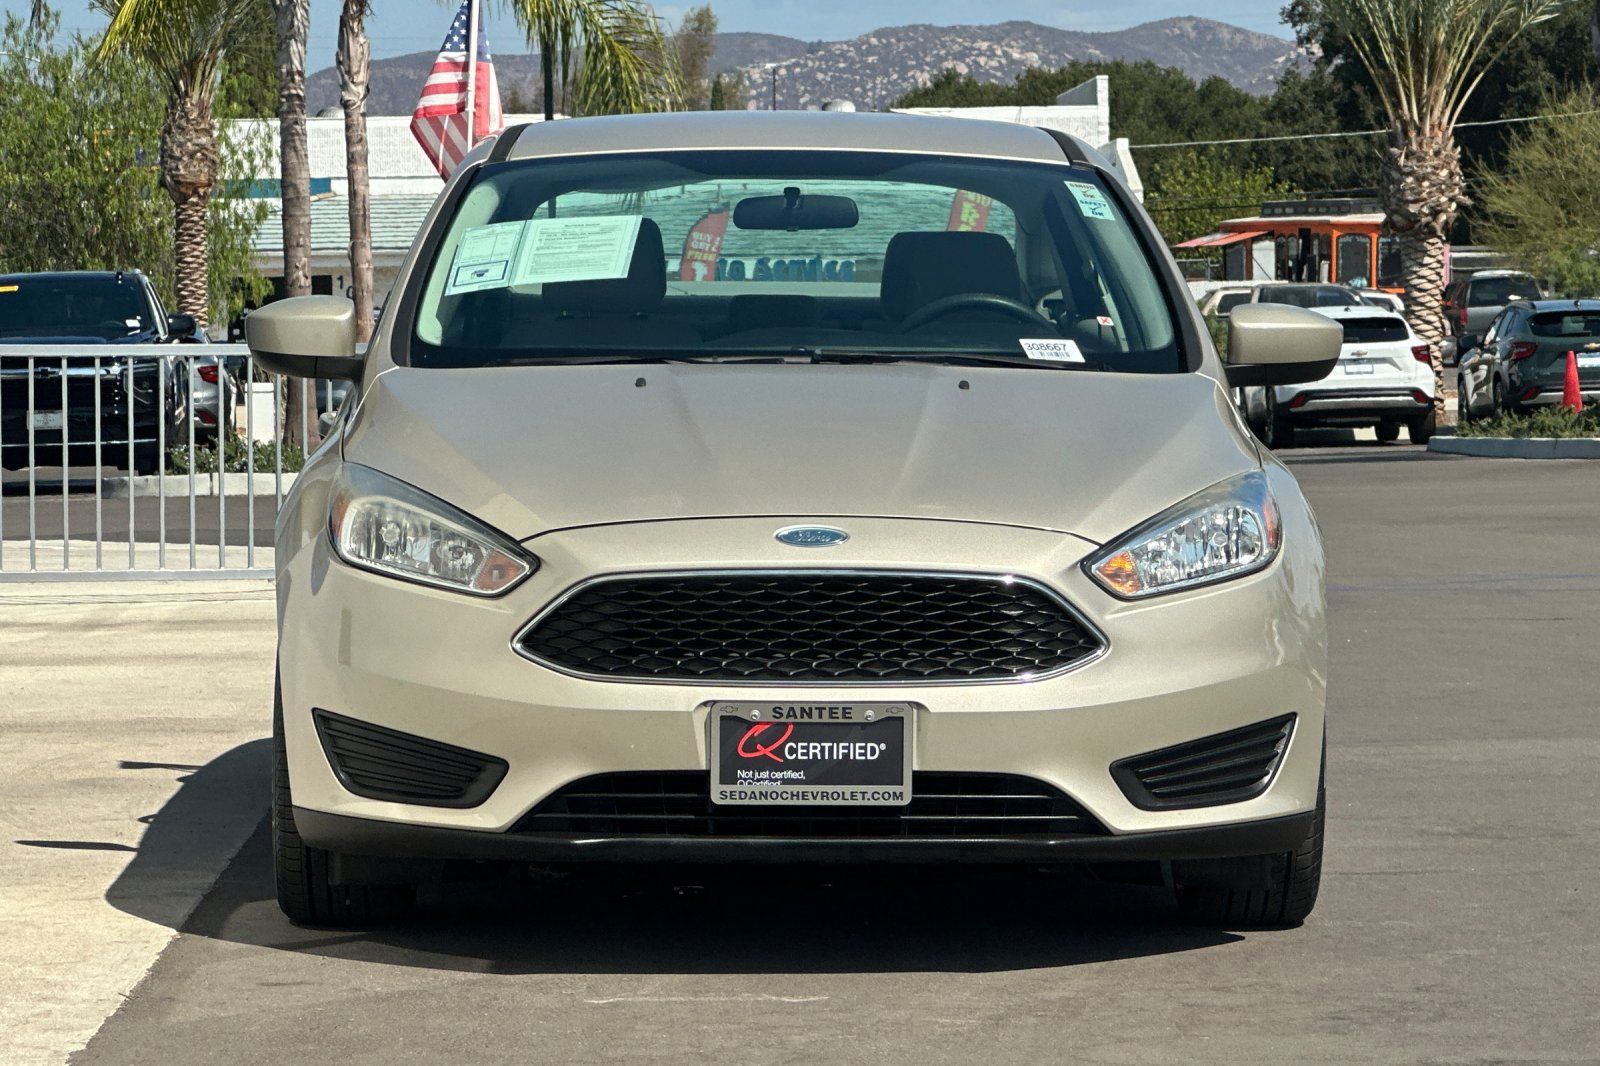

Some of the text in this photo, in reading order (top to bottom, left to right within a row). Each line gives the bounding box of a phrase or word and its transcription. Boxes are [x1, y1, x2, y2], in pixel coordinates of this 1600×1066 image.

[1024, 343, 1067, 351] 308667
[772, 706, 853, 720] SANTEE
[737, 769, 754, 779] Not
[753, 770, 769, 781] just
[719, 790, 904, 801] SEDANOCHEVROLET.COM
